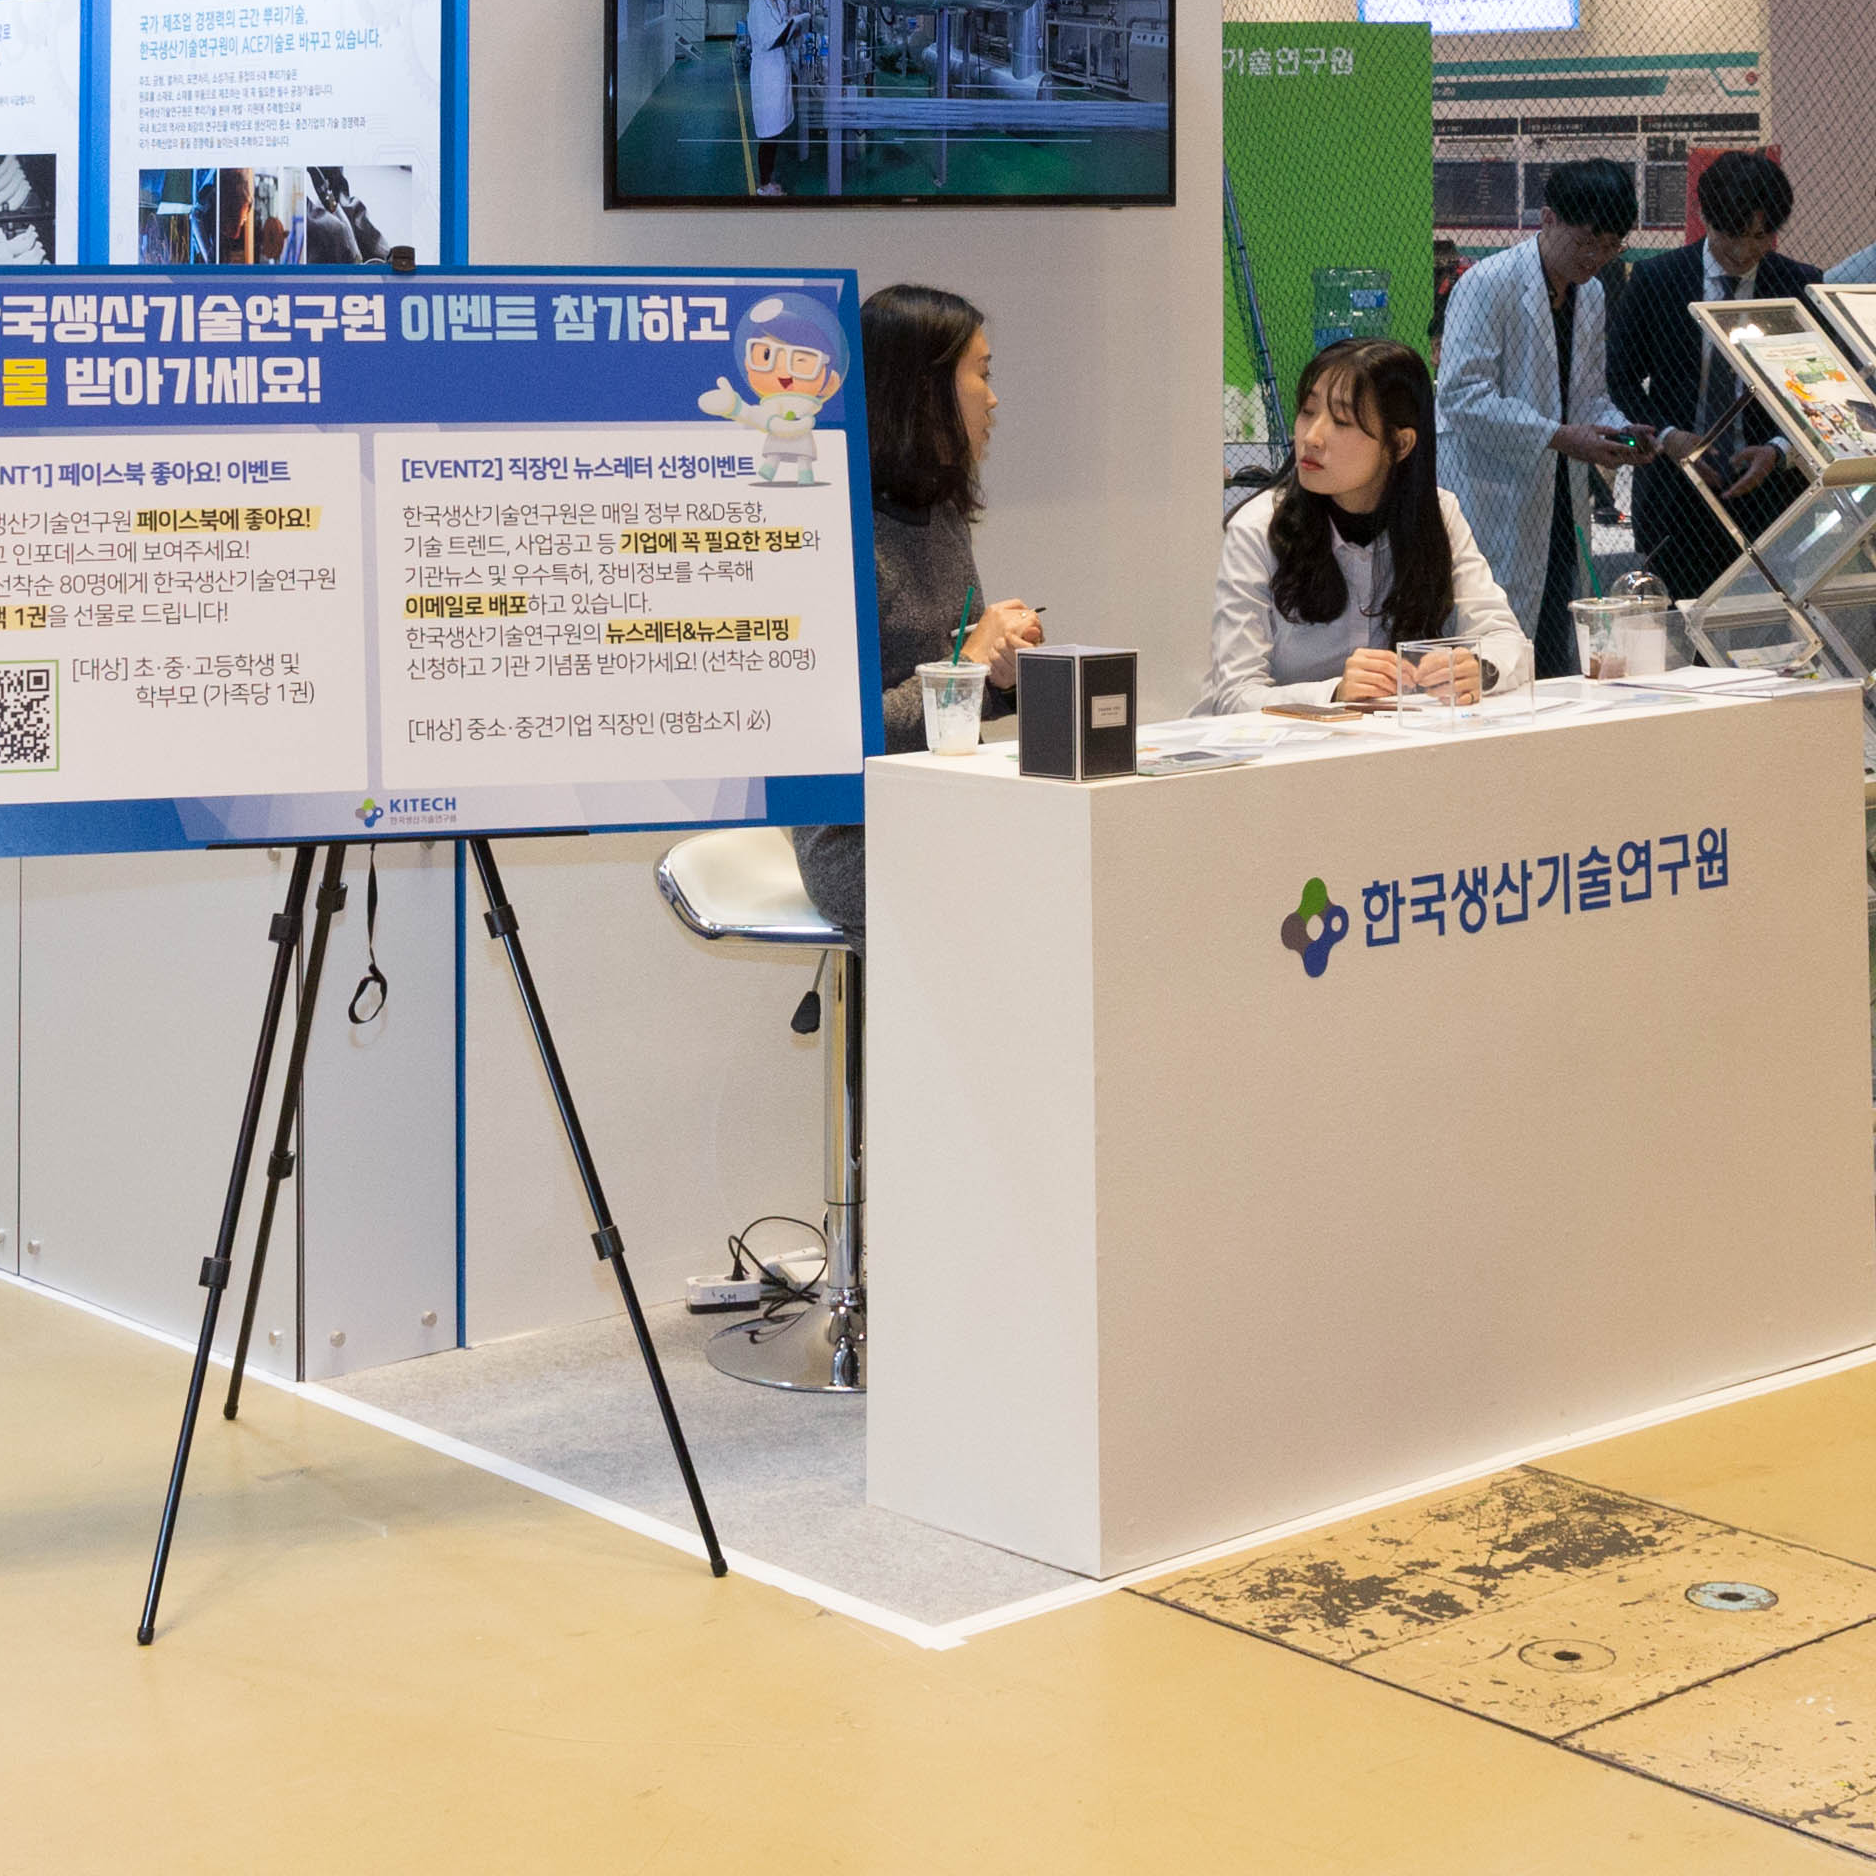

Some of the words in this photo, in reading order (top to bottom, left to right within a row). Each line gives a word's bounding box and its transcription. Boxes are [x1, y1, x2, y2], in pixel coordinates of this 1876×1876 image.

[140, 14, 159, 35] 국가
[162, 12, 191, 33] 제조업
[196, 11, 235, 32] 경쟁력의
[239, 10, 259, 28] 근간
[263, 5, 308, 26] 뿌리기술,
[299, 30, 331, 52] 바꾸고
[335, 27, 383, 50] 있습니다.
[400, 295, 539, 342] 이벤트
[552, 293, 731, 343] 참가하고
[65, 356, 322, 406] 받아가세요!
[58, 462, 145, 487] 페이스북
[150, 461, 221, 485] 좋아요!
[227, 460, 291, 484] 이벤트
[401, 458, 504, 482] [EVENT2]
[508, 456, 569, 481] 직장인
[574, 456, 653, 480] 뉴스레터
[658, 455, 756, 479] 신청이벤트
[136, 509, 240, 533] 페이스북에
[243, 507, 312, 531] 좋아요!
[402, 502, 598, 528] 한국생산기술연구원은
[601, 502, 641, 525] 매일
[644, 502, 682, 525] 정부
[686, 500, 768, 524] R&D동향,
[11, 541, 137, 566] 인포데스크에
[141, 539, 250, 563] 보여주세요!
[403, 533, 444, 558] 기술
[447, 532, 511, 558] 트렌드,
[515, 531, 593, 557] 사업공고
[597, 531, 616, 556] 등
[620, 531, 678, 555] 기업에
[681, 531, 700, 554] 꼭
[705, 530, 761, 553] 필요한
[764, 529, 821, 553] 정보와
[59, 571, 149, 596] 80명에게
[152, 567, 337, 594] 한국생산기술연구원
[404, 563, 484, 589] 기관뉴스
[487, 563, 508, 587] 및
[512, 561, 594, 588] 우수특허,
[597, 560, 693, 586] 장비정보를
[697, 559, 754, 584] 수록해
[14, 603, 69, 629] 1권을
[73, 602, 136, 627] 선물로
[140, 600, 229, 625] 드립니다!
[405, 593, 485, 618] 이메일로
[489, 593, 567, 617] 배포하고
[571, 591, 652, 616] 있습니다.
[406, 623, 602, 650] 한국생산기술연구원의
[606, 620, 790, 645] 뉴스레터&뉴스클리핑
[71, 657, 129, 683] [대상]
[133, 652, 276, 678] 초·중·고등학생
[280, 651, 301, 676] 및
[407, 654, 486, 680] 신청하고
[490, 654, 530, 679] 기관
[534, 652, 594, 678] 기념품
[597, 651, 698, 676] 받아가세요!
[702, 649, 765, 675] (선착순
[768, 648, 817, 673] 80명)
[135, 684, 200, 709] 학부모
[203, 682, 270, 707] (가족당
[276, 680, 316, 705] 1권)
[407, 717, 463, 744] [대상]
[466, 713, 593, 742] 중소·중견기업
[597, 712, 656, 738] 직장인
[659, 709, 741, 736] (명함소지
[389, 797, 457, 813] KITECH
[1361, 826, 1731, 948] 한국생산기술연구원
